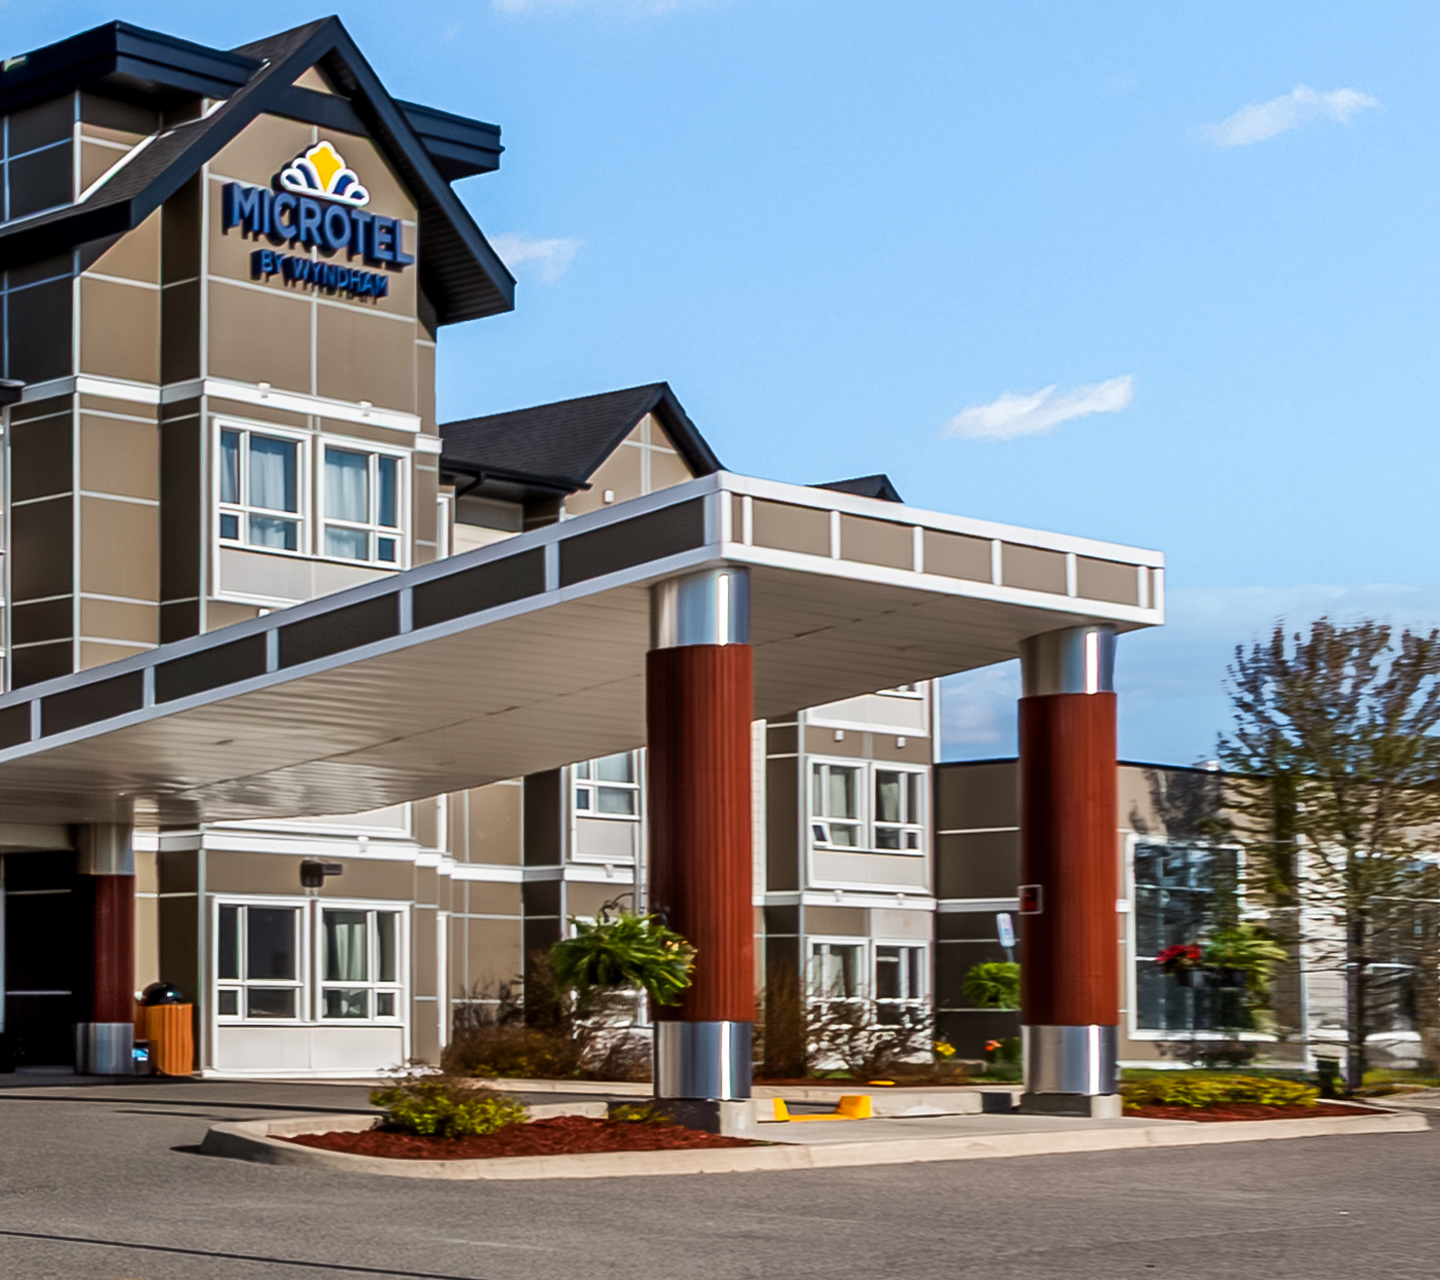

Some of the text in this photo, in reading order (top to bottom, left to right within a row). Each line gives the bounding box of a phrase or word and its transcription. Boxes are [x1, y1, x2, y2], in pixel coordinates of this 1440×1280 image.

[228, 183, 415, 265] MICROTEL
[258, 250, 389, 297] BY WYNDHAM
